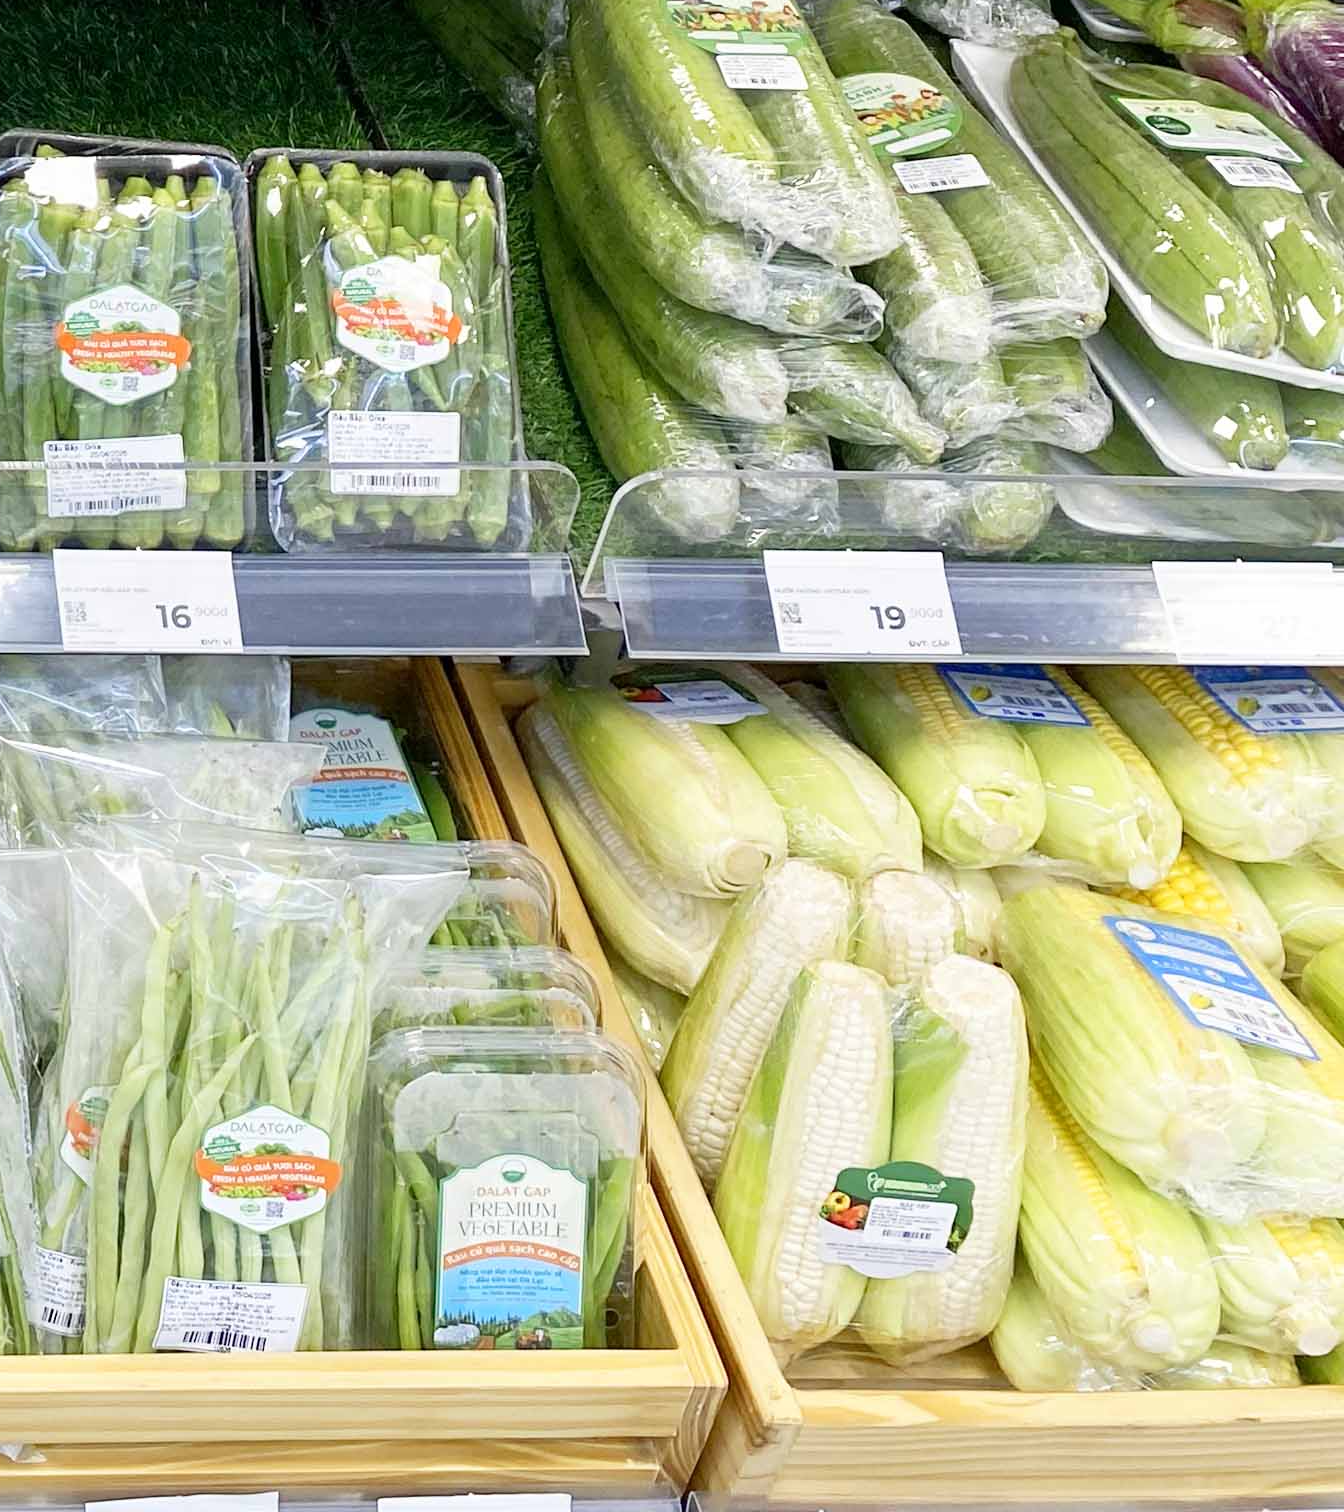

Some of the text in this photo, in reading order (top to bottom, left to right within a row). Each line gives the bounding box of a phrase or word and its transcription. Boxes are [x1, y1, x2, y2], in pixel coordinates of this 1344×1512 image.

[156, 605, 191, 628] 16
[871, 607, 905, 629] 19
[229, 1121, 304, 1135] DALATGAP
[476, 1186, 551, 1198] DALAT GAP
[469, 1201, 558, 1218] PREMIUM
[458, 1220, 569, 1238] VEGETABLE
